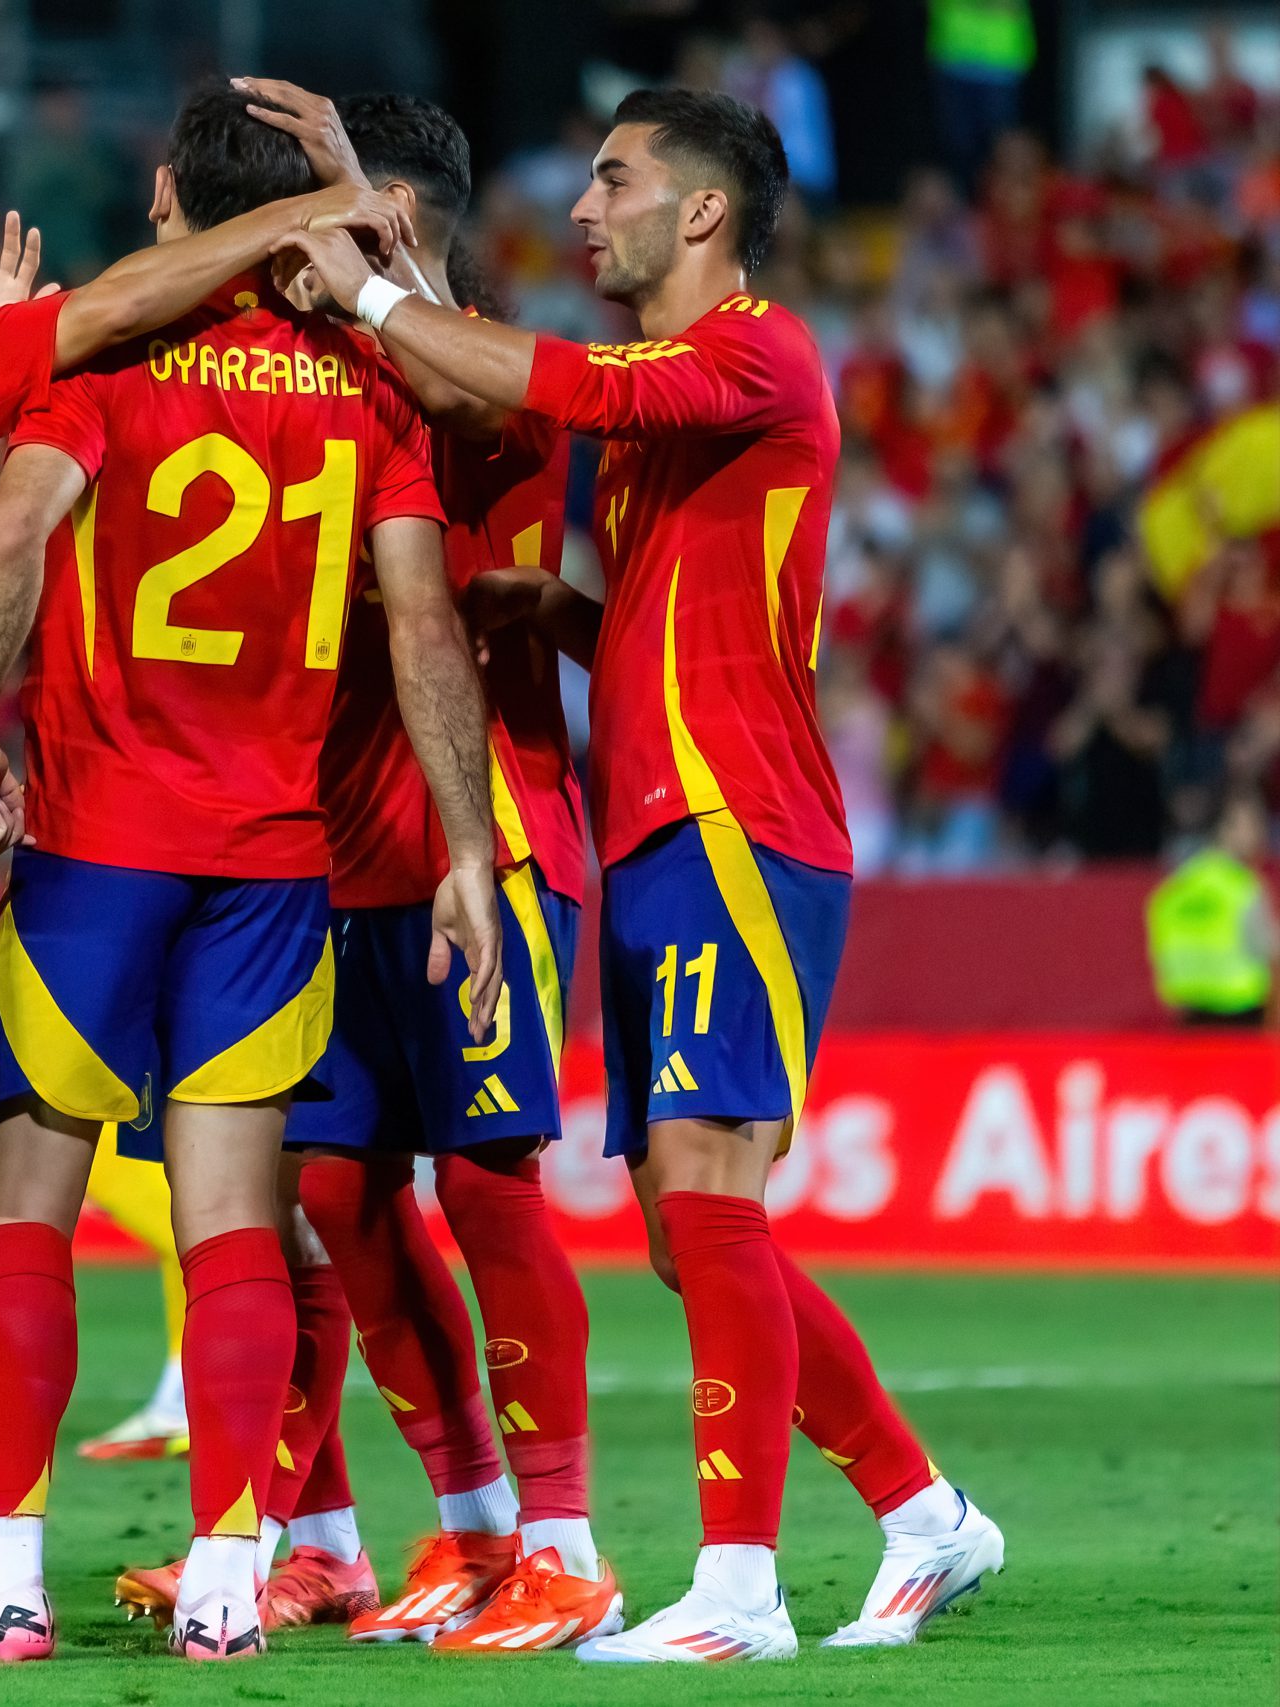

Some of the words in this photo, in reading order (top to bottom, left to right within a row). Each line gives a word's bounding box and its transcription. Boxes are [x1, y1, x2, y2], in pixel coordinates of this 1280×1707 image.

[148, 339, 362, 397] OYARZABAL
[132, 432, 357, 670] 21
[458, 975, 511, 1062] 9
[656, 943, 717, 1037] 11
